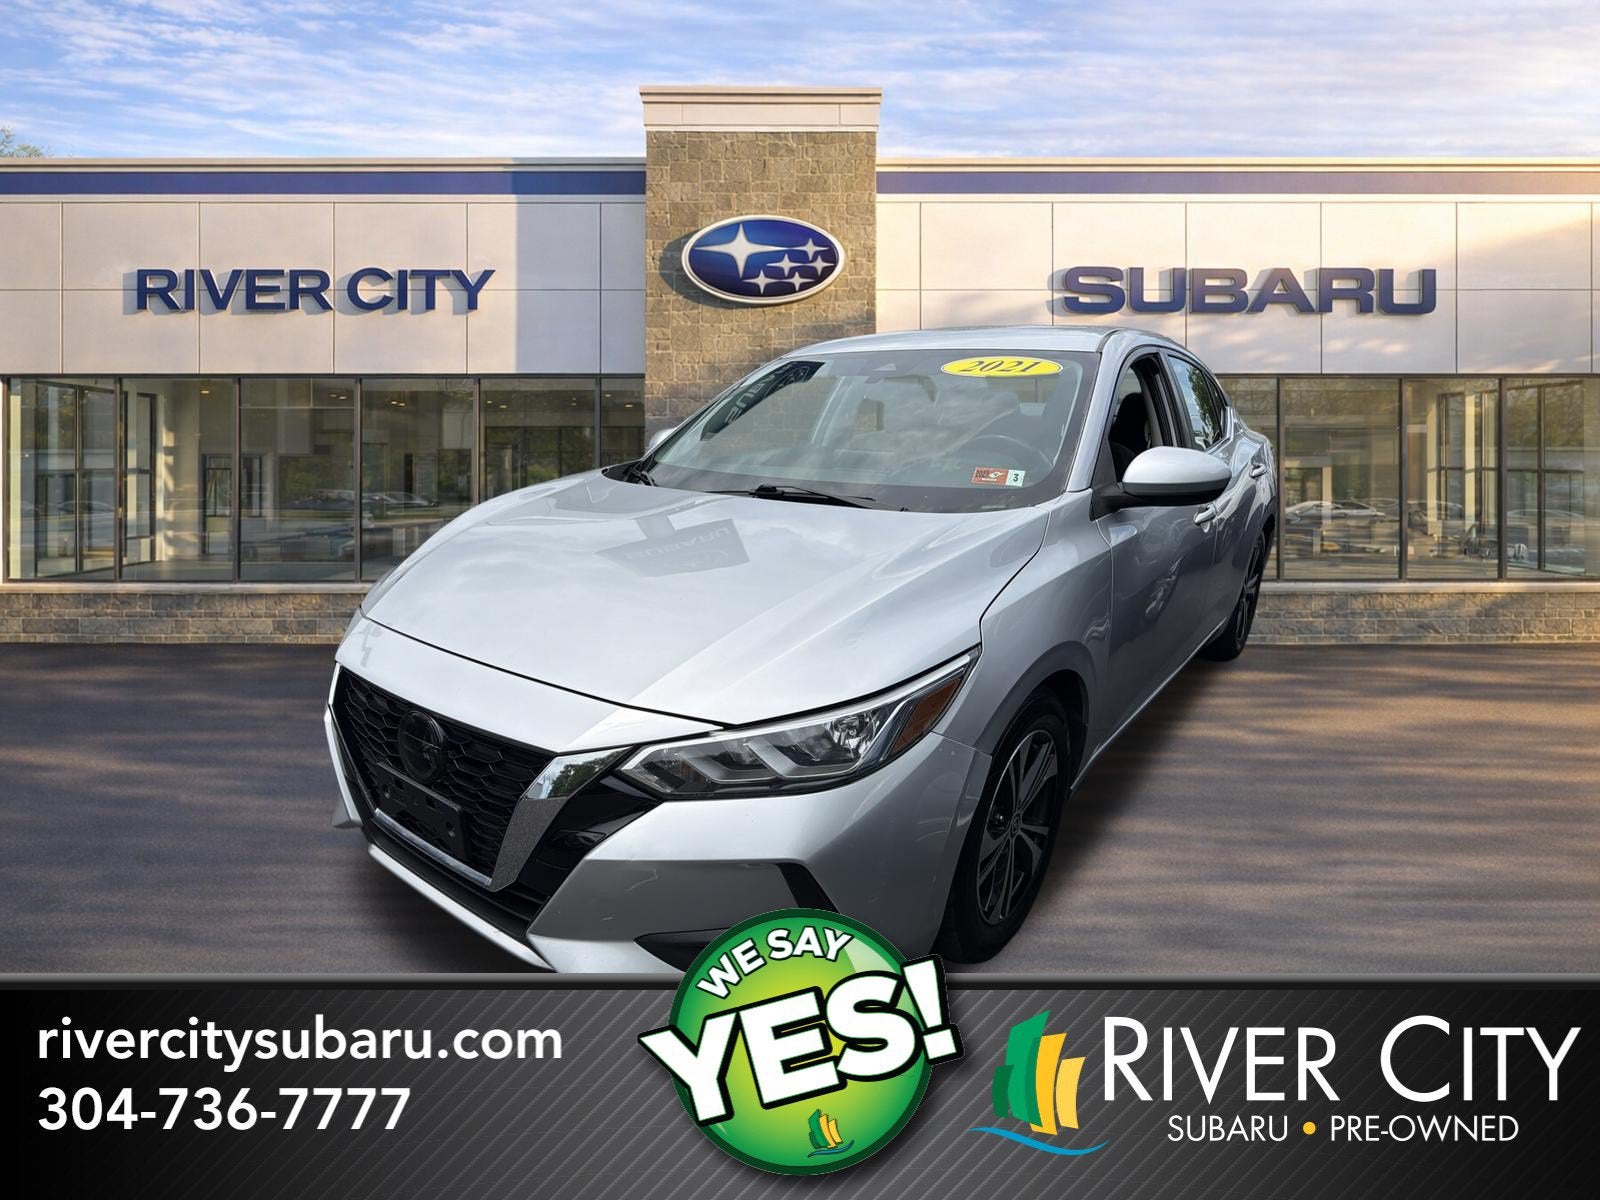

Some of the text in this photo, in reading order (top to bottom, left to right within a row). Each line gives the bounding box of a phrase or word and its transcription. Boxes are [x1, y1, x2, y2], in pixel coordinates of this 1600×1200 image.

[136, 267, 496, 311] RIVER CITY
[1062, 266, 1437, 315] SUBARU
[958, 360, 1042, 373] 2021
[1012, 473, 1020, 482] 3
